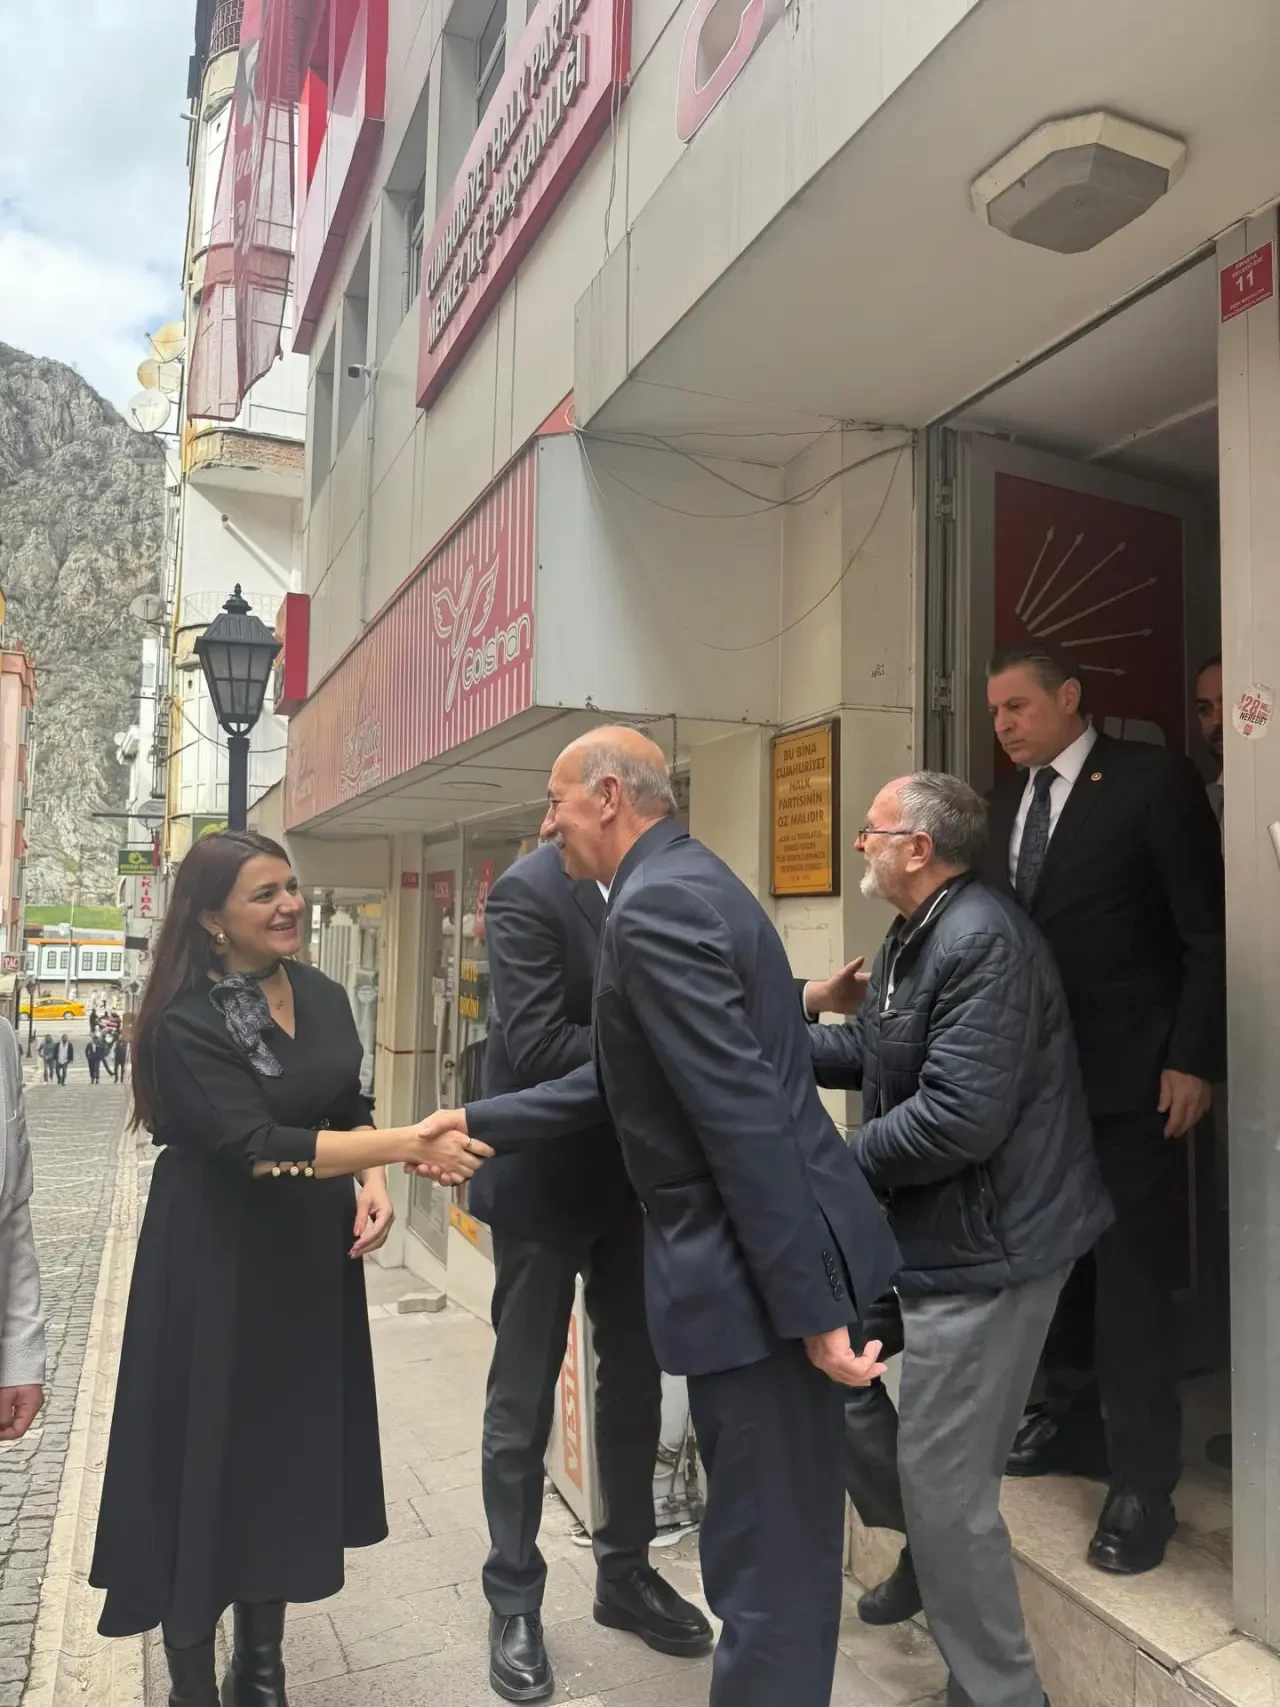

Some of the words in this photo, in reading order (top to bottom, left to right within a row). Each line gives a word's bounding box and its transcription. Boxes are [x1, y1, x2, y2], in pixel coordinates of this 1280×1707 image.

[426, 145, 490, 299] CUMHURİYET
[492, 64, 529, 172] HALK
[530, 0, 584, 97] PART
[427, 252, 467, 351] MERKEZ
[467, 206, 492, 281] İLÇE
[1236, 269, 1254, 292] 11
[783, 748, 795, 761] BU
[796, 742, 817, 758] BİNA
[776, 756, 826, 779] CUMHURİYET
[789, 777, 811, 792] HALK
[778, 790, 822, 810] PARTİSİNİN
[790, 809, 824, 825] MALIDIR
